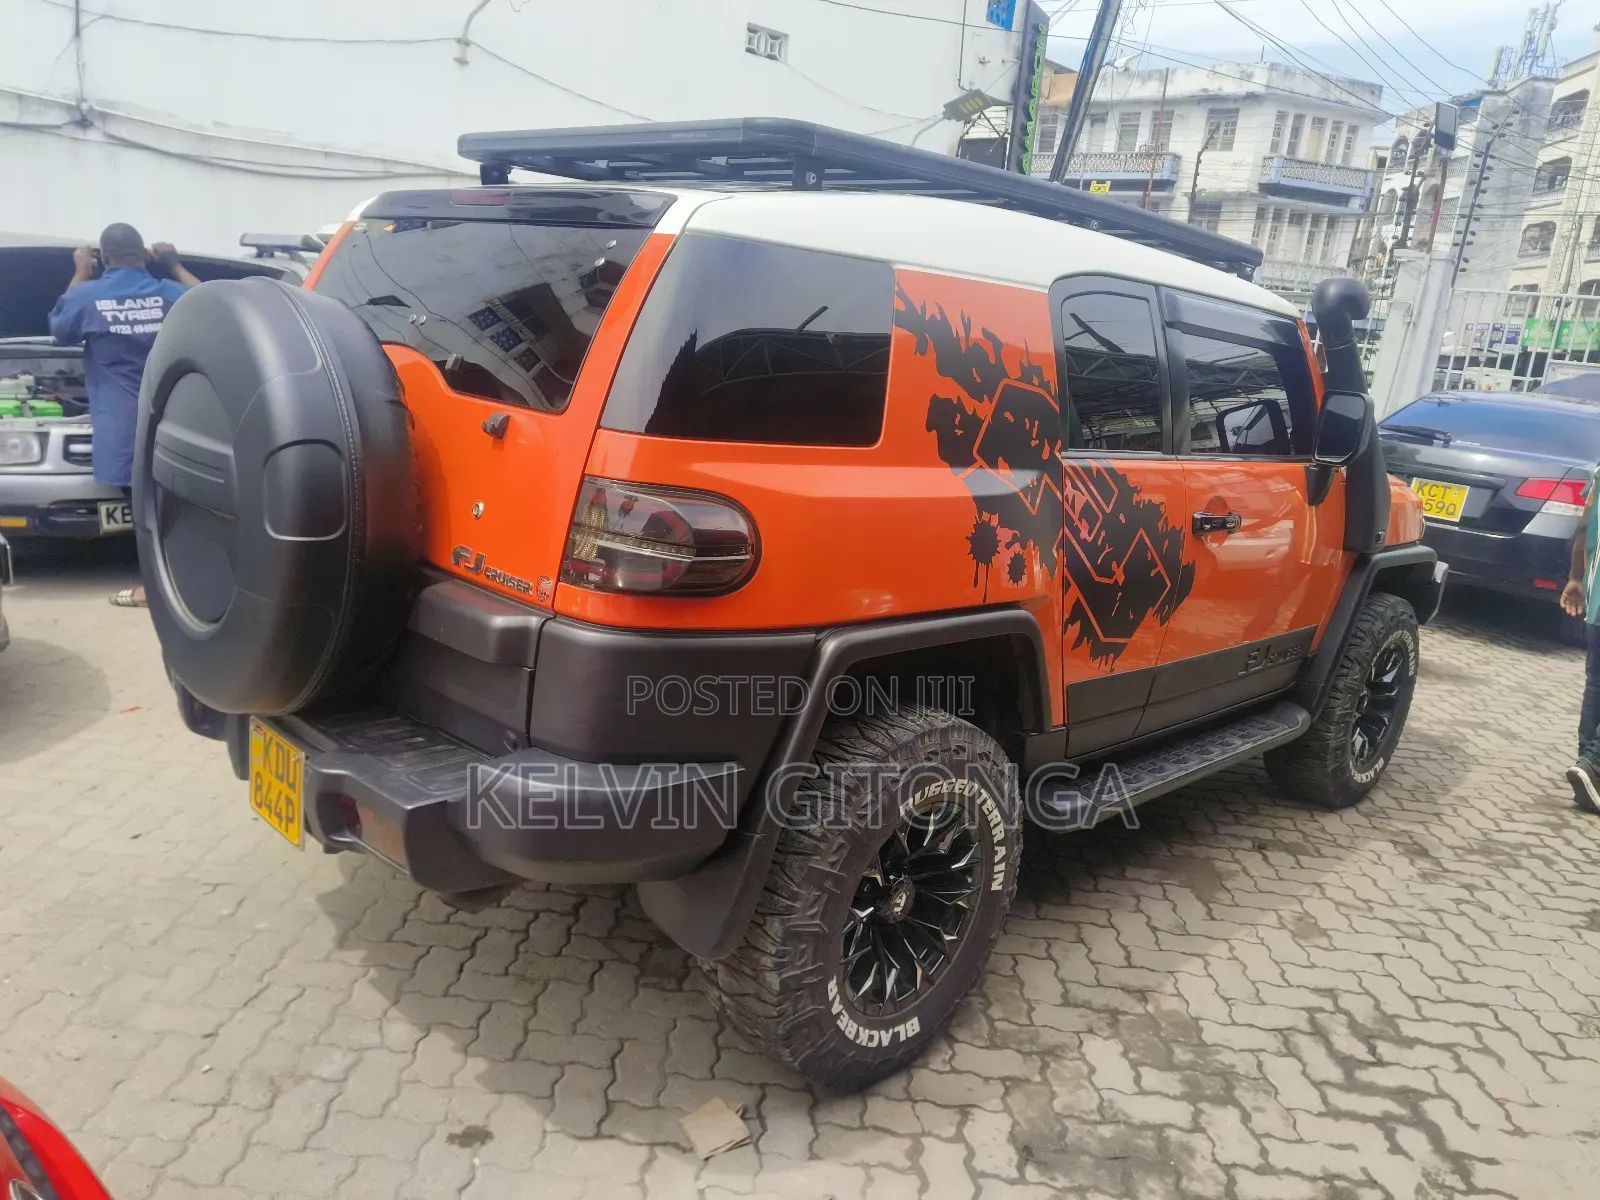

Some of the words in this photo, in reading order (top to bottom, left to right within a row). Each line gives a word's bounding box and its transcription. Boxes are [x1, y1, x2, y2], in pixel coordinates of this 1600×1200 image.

[95, 296, 164, 311] ISLAND
[102, 308, 164, 322] TYRES
[1416, 481, 1452, 500] KCT
[484, 566, 533, 596] CRUISER
[254, 771, 295, 834] 844P
[975, 788, 1008, 891] TERRAIN
[827, 974, 921, 1048] BLACKBEAR
